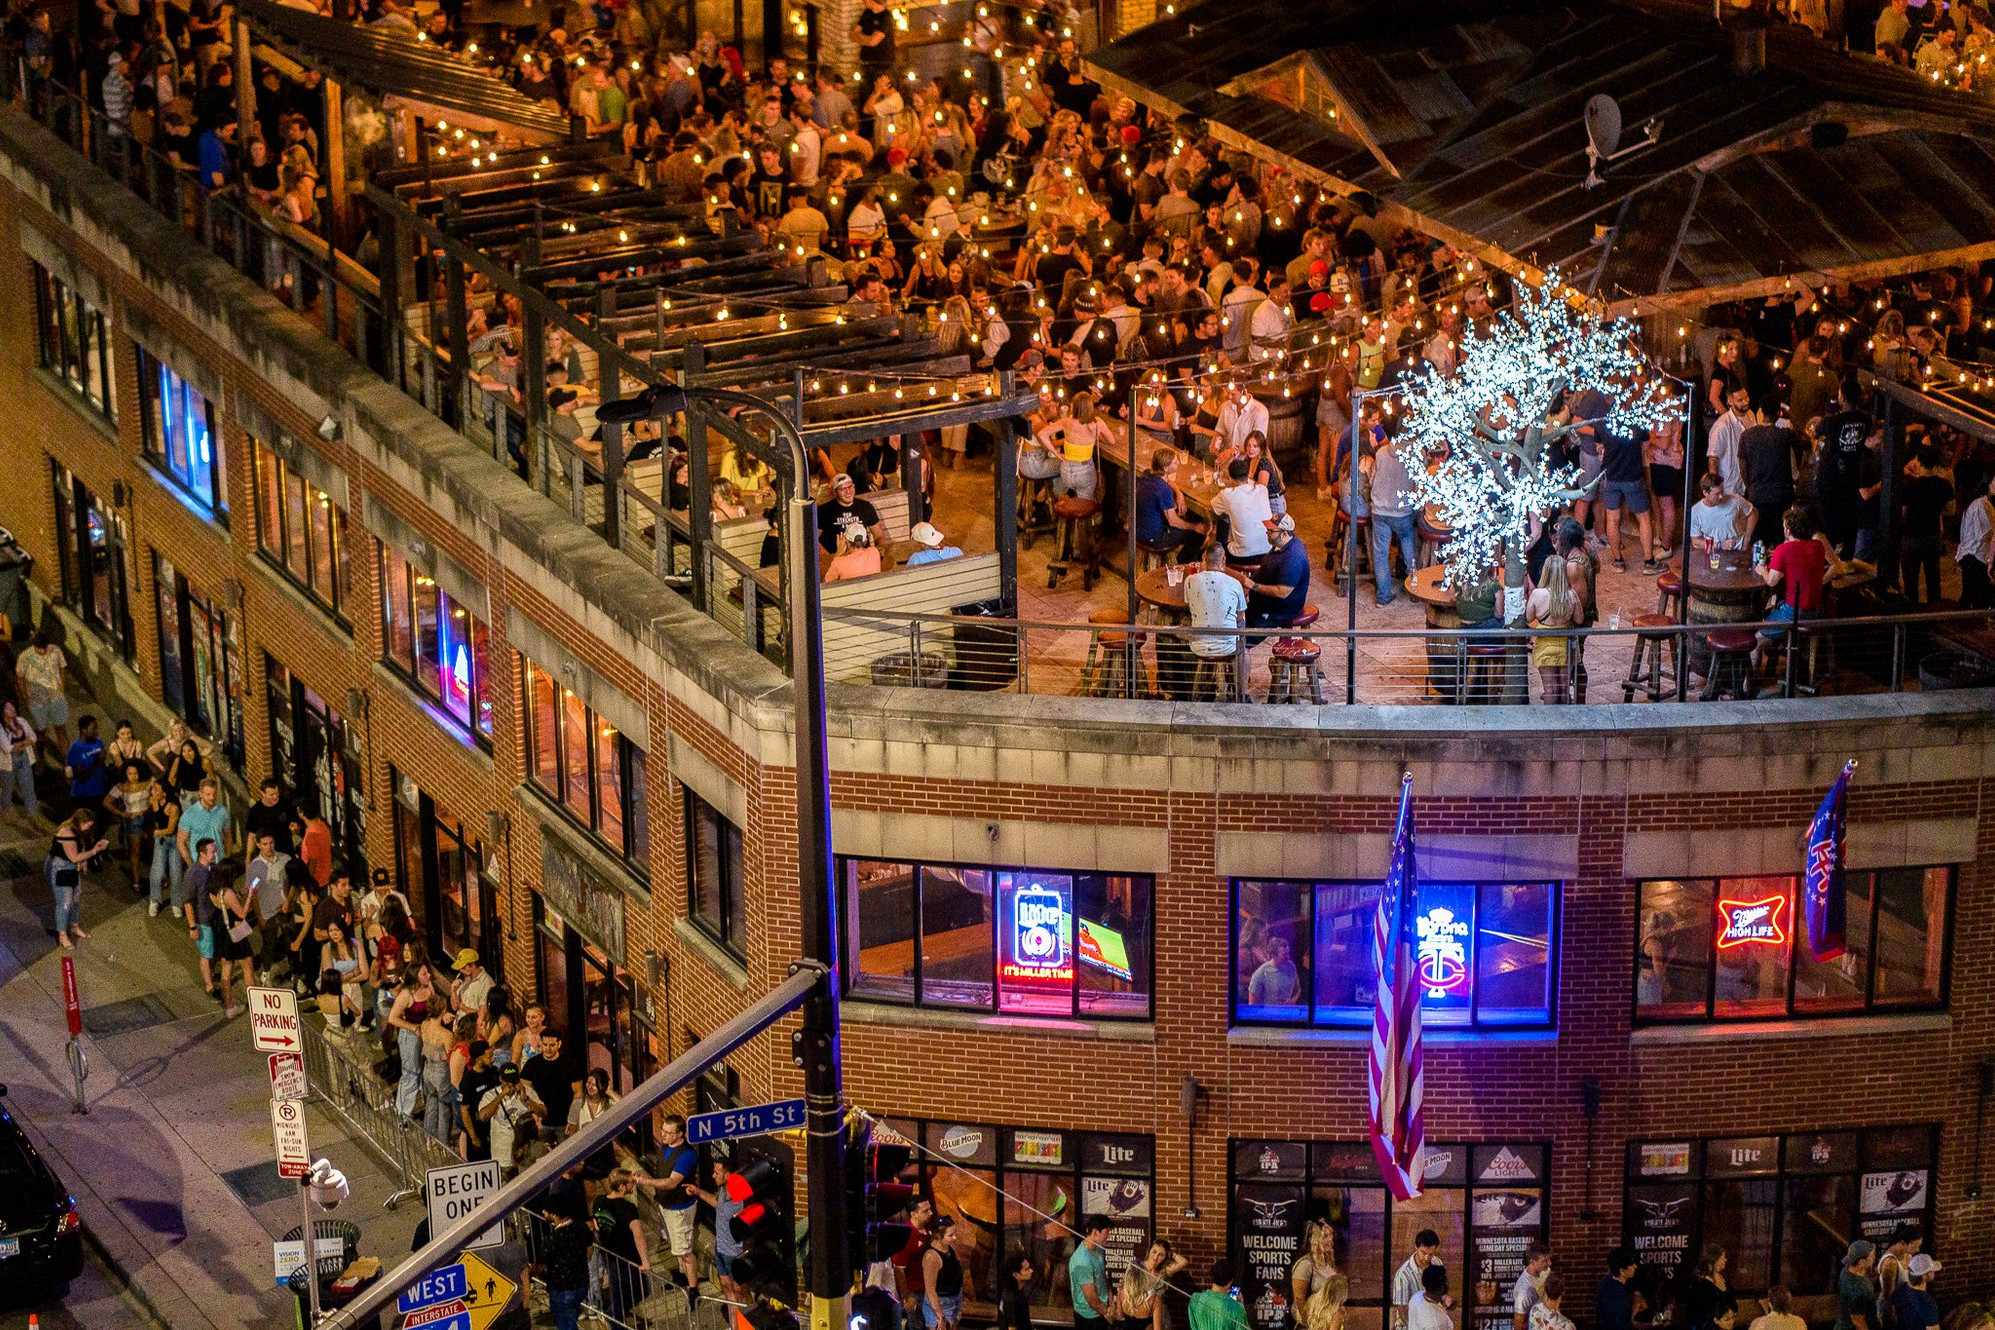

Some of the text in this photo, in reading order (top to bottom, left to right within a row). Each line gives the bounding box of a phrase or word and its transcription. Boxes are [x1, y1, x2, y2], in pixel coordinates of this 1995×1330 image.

[1019, 902, 1059, 927] Lite
[1732, 905, 1770, 928] Miller
[1727, 925, 1774, 938] HIGH LIFE
[1004, 966, 1073, 979] IT'S MILLER TIME
[263, 994, 281, 1009] NO
[253, 1013, 297, 1030] PARKING
[698, 1105, 795, 1138] N 5th St
[940, 1133, 981, 1150] BLUE MOON
[1101, 1144, 1134, 1164] Lite
[1429, 1153, 1451, 1165] MOON
[1730, 1148, 1761, 1166] Lite
[1488, 1157, 1527, 1170] Coors
[1494, 1169, 1520, 1177] LIGHT
[434, 1170, 494, 1197] BEGIN
[1086, 1180, 1109, 1193] Lite
[1866, 1176, 1888, 1189] Lite
[1115, 1234, 1142, 1243] SPECIALS
[1119, 1227, 1146, 1237] BASEBALL
[1243, 1235, 1298, 1250] WELCOME
[1634, 1234, 1689, 1249] WELCOME
[1249, 1250, 1292, 1265] SPORTS
[1640, 1250, 1682, 1265] SPORTS
[1256, 1266, 1285, 1280] FANS
[1480, 1259, 1493, 1273] $3
[407, 1272, 457, 1304] WEST
[411, 1304, 459, 1325] INTERSTATE
[1257, 1309, 1284, 1321] IPA
